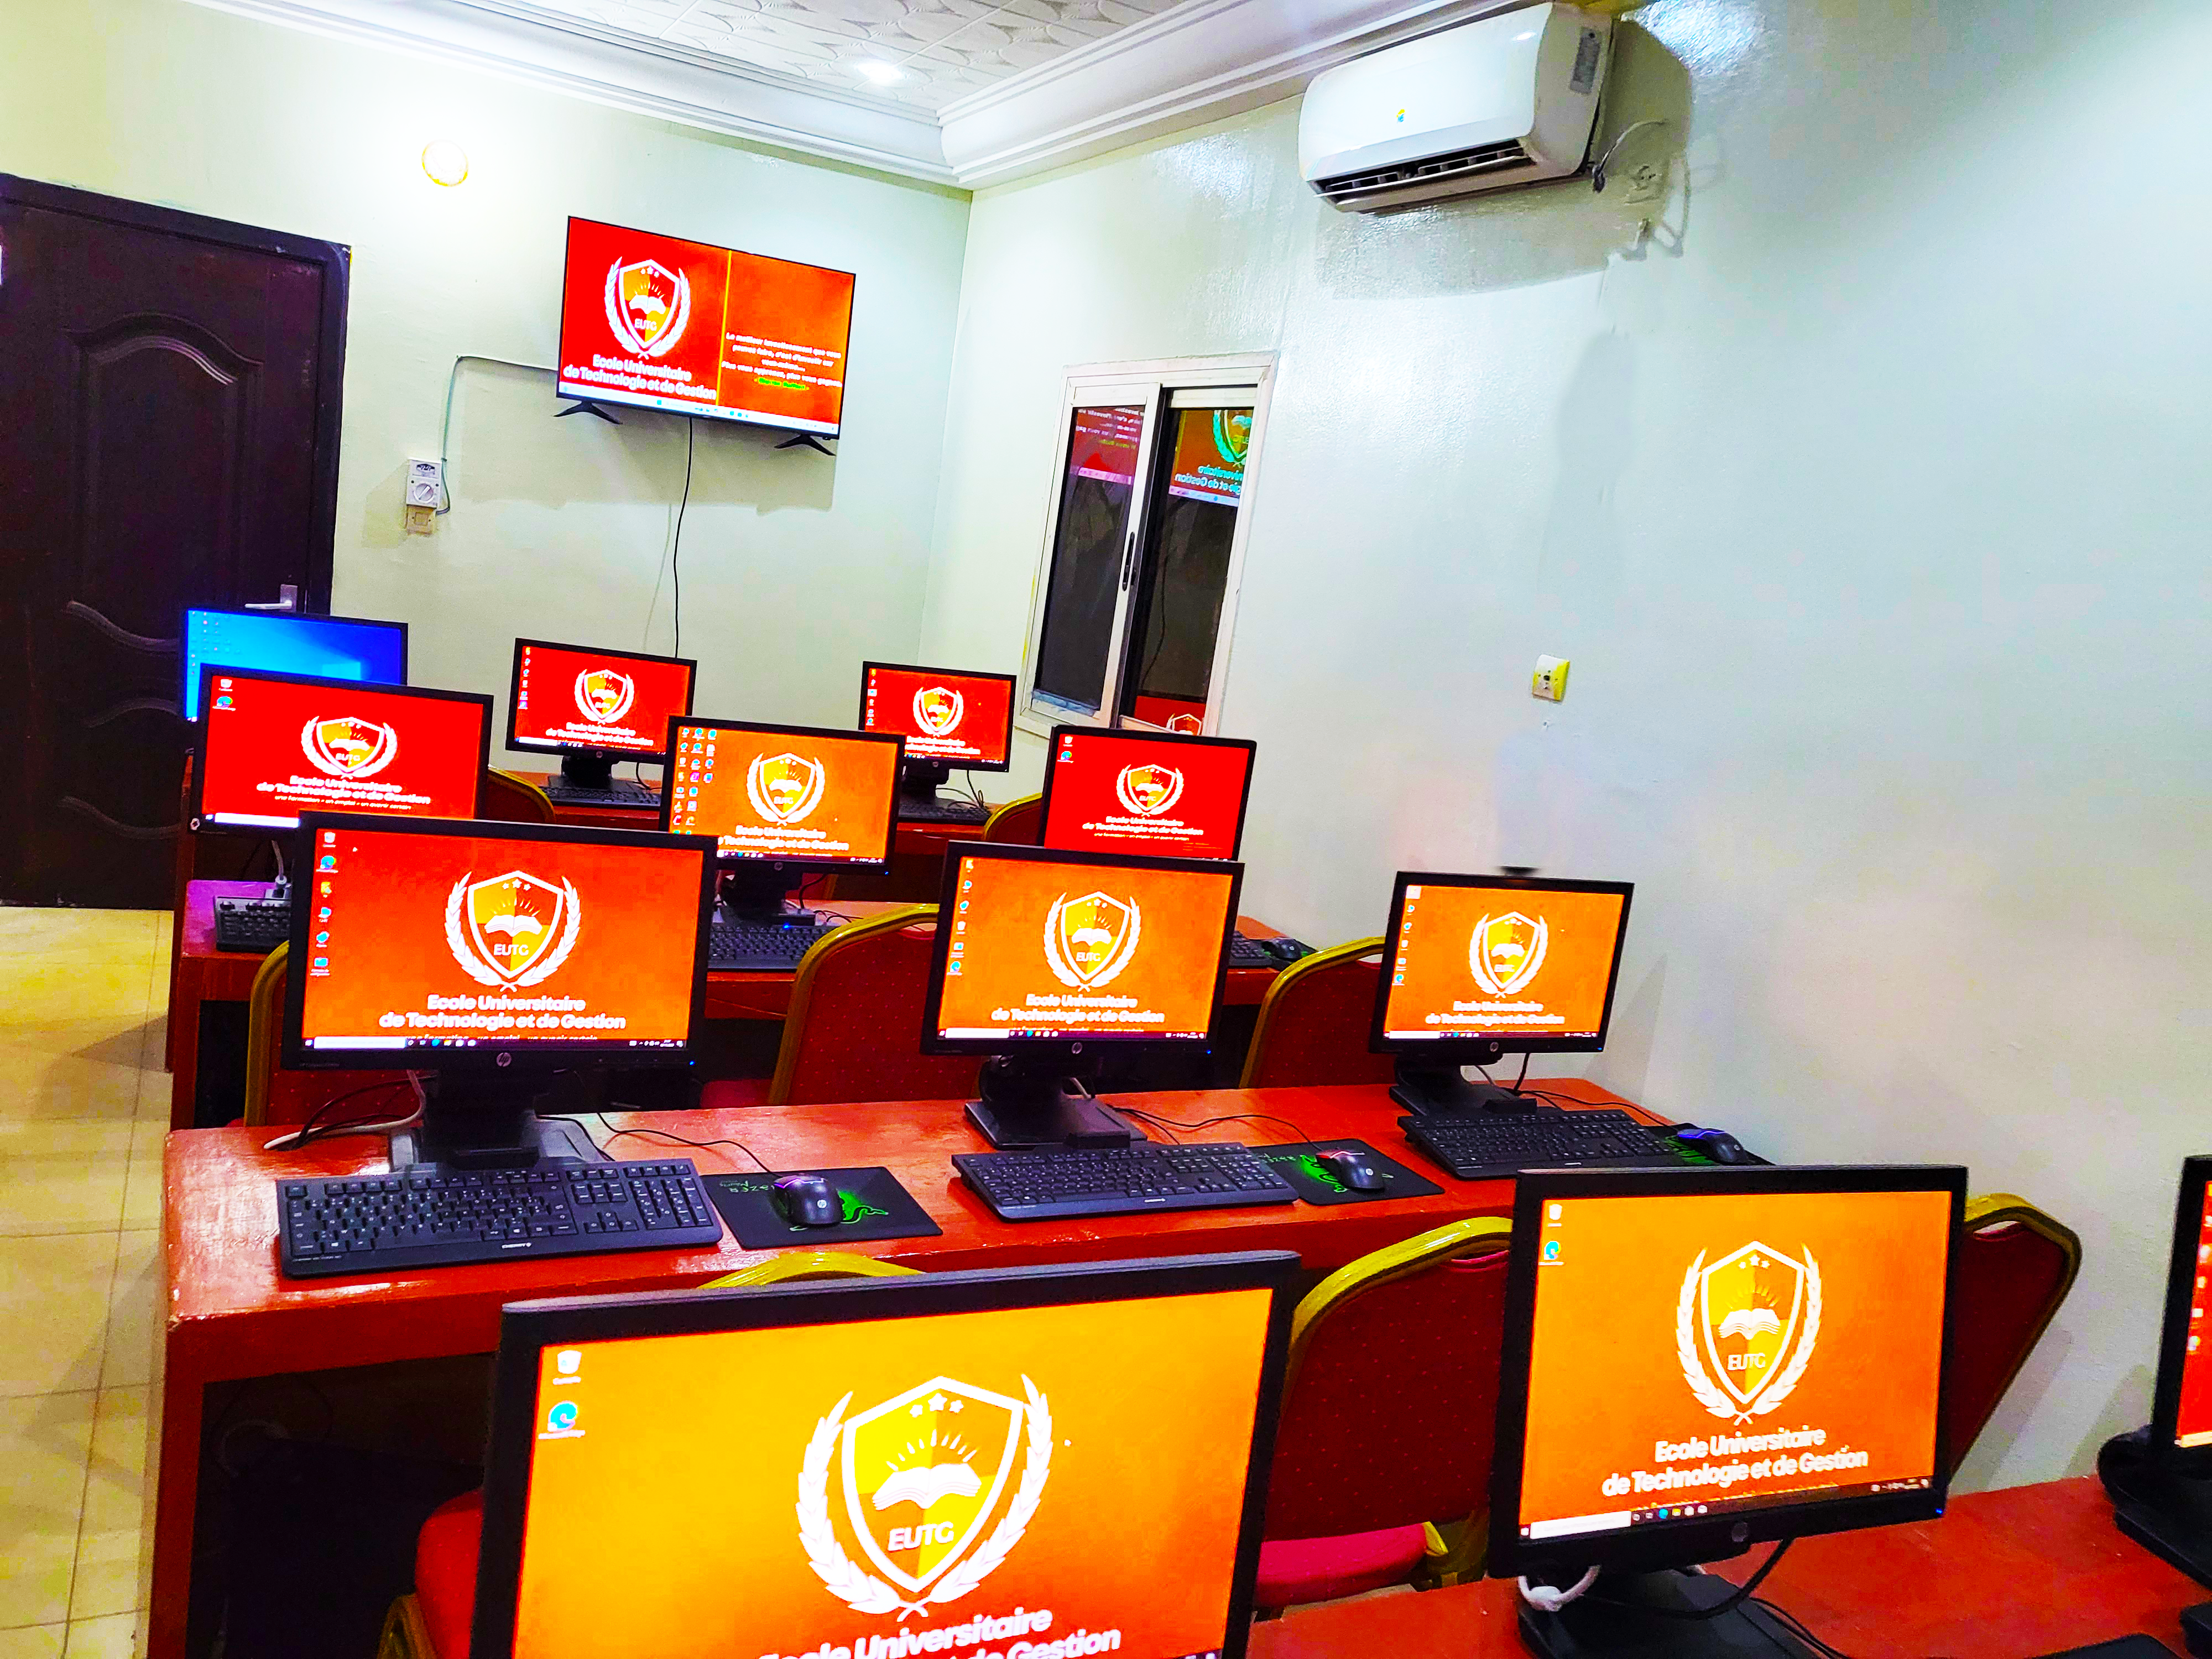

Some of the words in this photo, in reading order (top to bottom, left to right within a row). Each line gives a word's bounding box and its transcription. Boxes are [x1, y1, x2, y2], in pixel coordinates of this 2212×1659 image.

[593, 354, 623, 371] Ecole
[624, 359, 691, 382] Universitaire
[564, 364, 580, 378] de
[580, 367, 646, 390] Technologie
[647, 379, 660, 391] et
[659, 379, 675, 393] de
[676, 382, 716, 400] Gestion
[257, 781, 275, 792] de
[275, 783, 352, 798] Technologie
[366, 791, 384, 801] de
[384, 793, 431, 804] Gestion
[290, 775, 325, 786] Ecole
[325, 778, 402, 793] Universitaire
[427, 994, 476, 1010] Ecole
[477, 994, 586, 1011] Universitaire
[1026, 994, 1061, 1006] Ecole
[1061, 994, 1138, 1008] Universitaire
[1453, 1000, 1481, 1011] Ecole
[1481, 1000, 1544, 1012] Universitaire
[379, 1011, 405, 1028] de
[405, 1012, 515, 1031] Technologie
[515, 1014, 536, 1029] et
[535, 1013, 560, 1029] de
[560, 1013, 626, 1029] Gestion
[990, 1008, 1010, 1021] de
[1010, 1008, 1087, 1025] Technologie
[1087, 1010, 1102, 1022] et
[1101, 1009, 1118, 1022] de
[1118, 1009, 1165, 1023] Gestion
[1425, 1013, 1441, 1024] de
[1440, 1013, 1502, 1027] Technologie
[1501, 1014, 1514, 1024] et
[1513, 1014, 1527, 1024] de
[1527, 1014, 1565, 1024] Gestion
[1655, 1436, 1709, 1463] Ecole
[1709, 1425, 1827, 1457] Universitaire
[1601, 1473, 1631, 1496] de
[1631, 1459, 1749, 1493] Technologie
[1750, 1459, 1772, 1479] et
[1772, 1455, 1798, 1478] de
[1798, 1446, 1869, 1473] Gestion
[887, 1521, 954, 1552] EUTG
[854, 1606, 1052, 1659] Universitaire
[1008, 1629, 1120, 1659] Gestion
